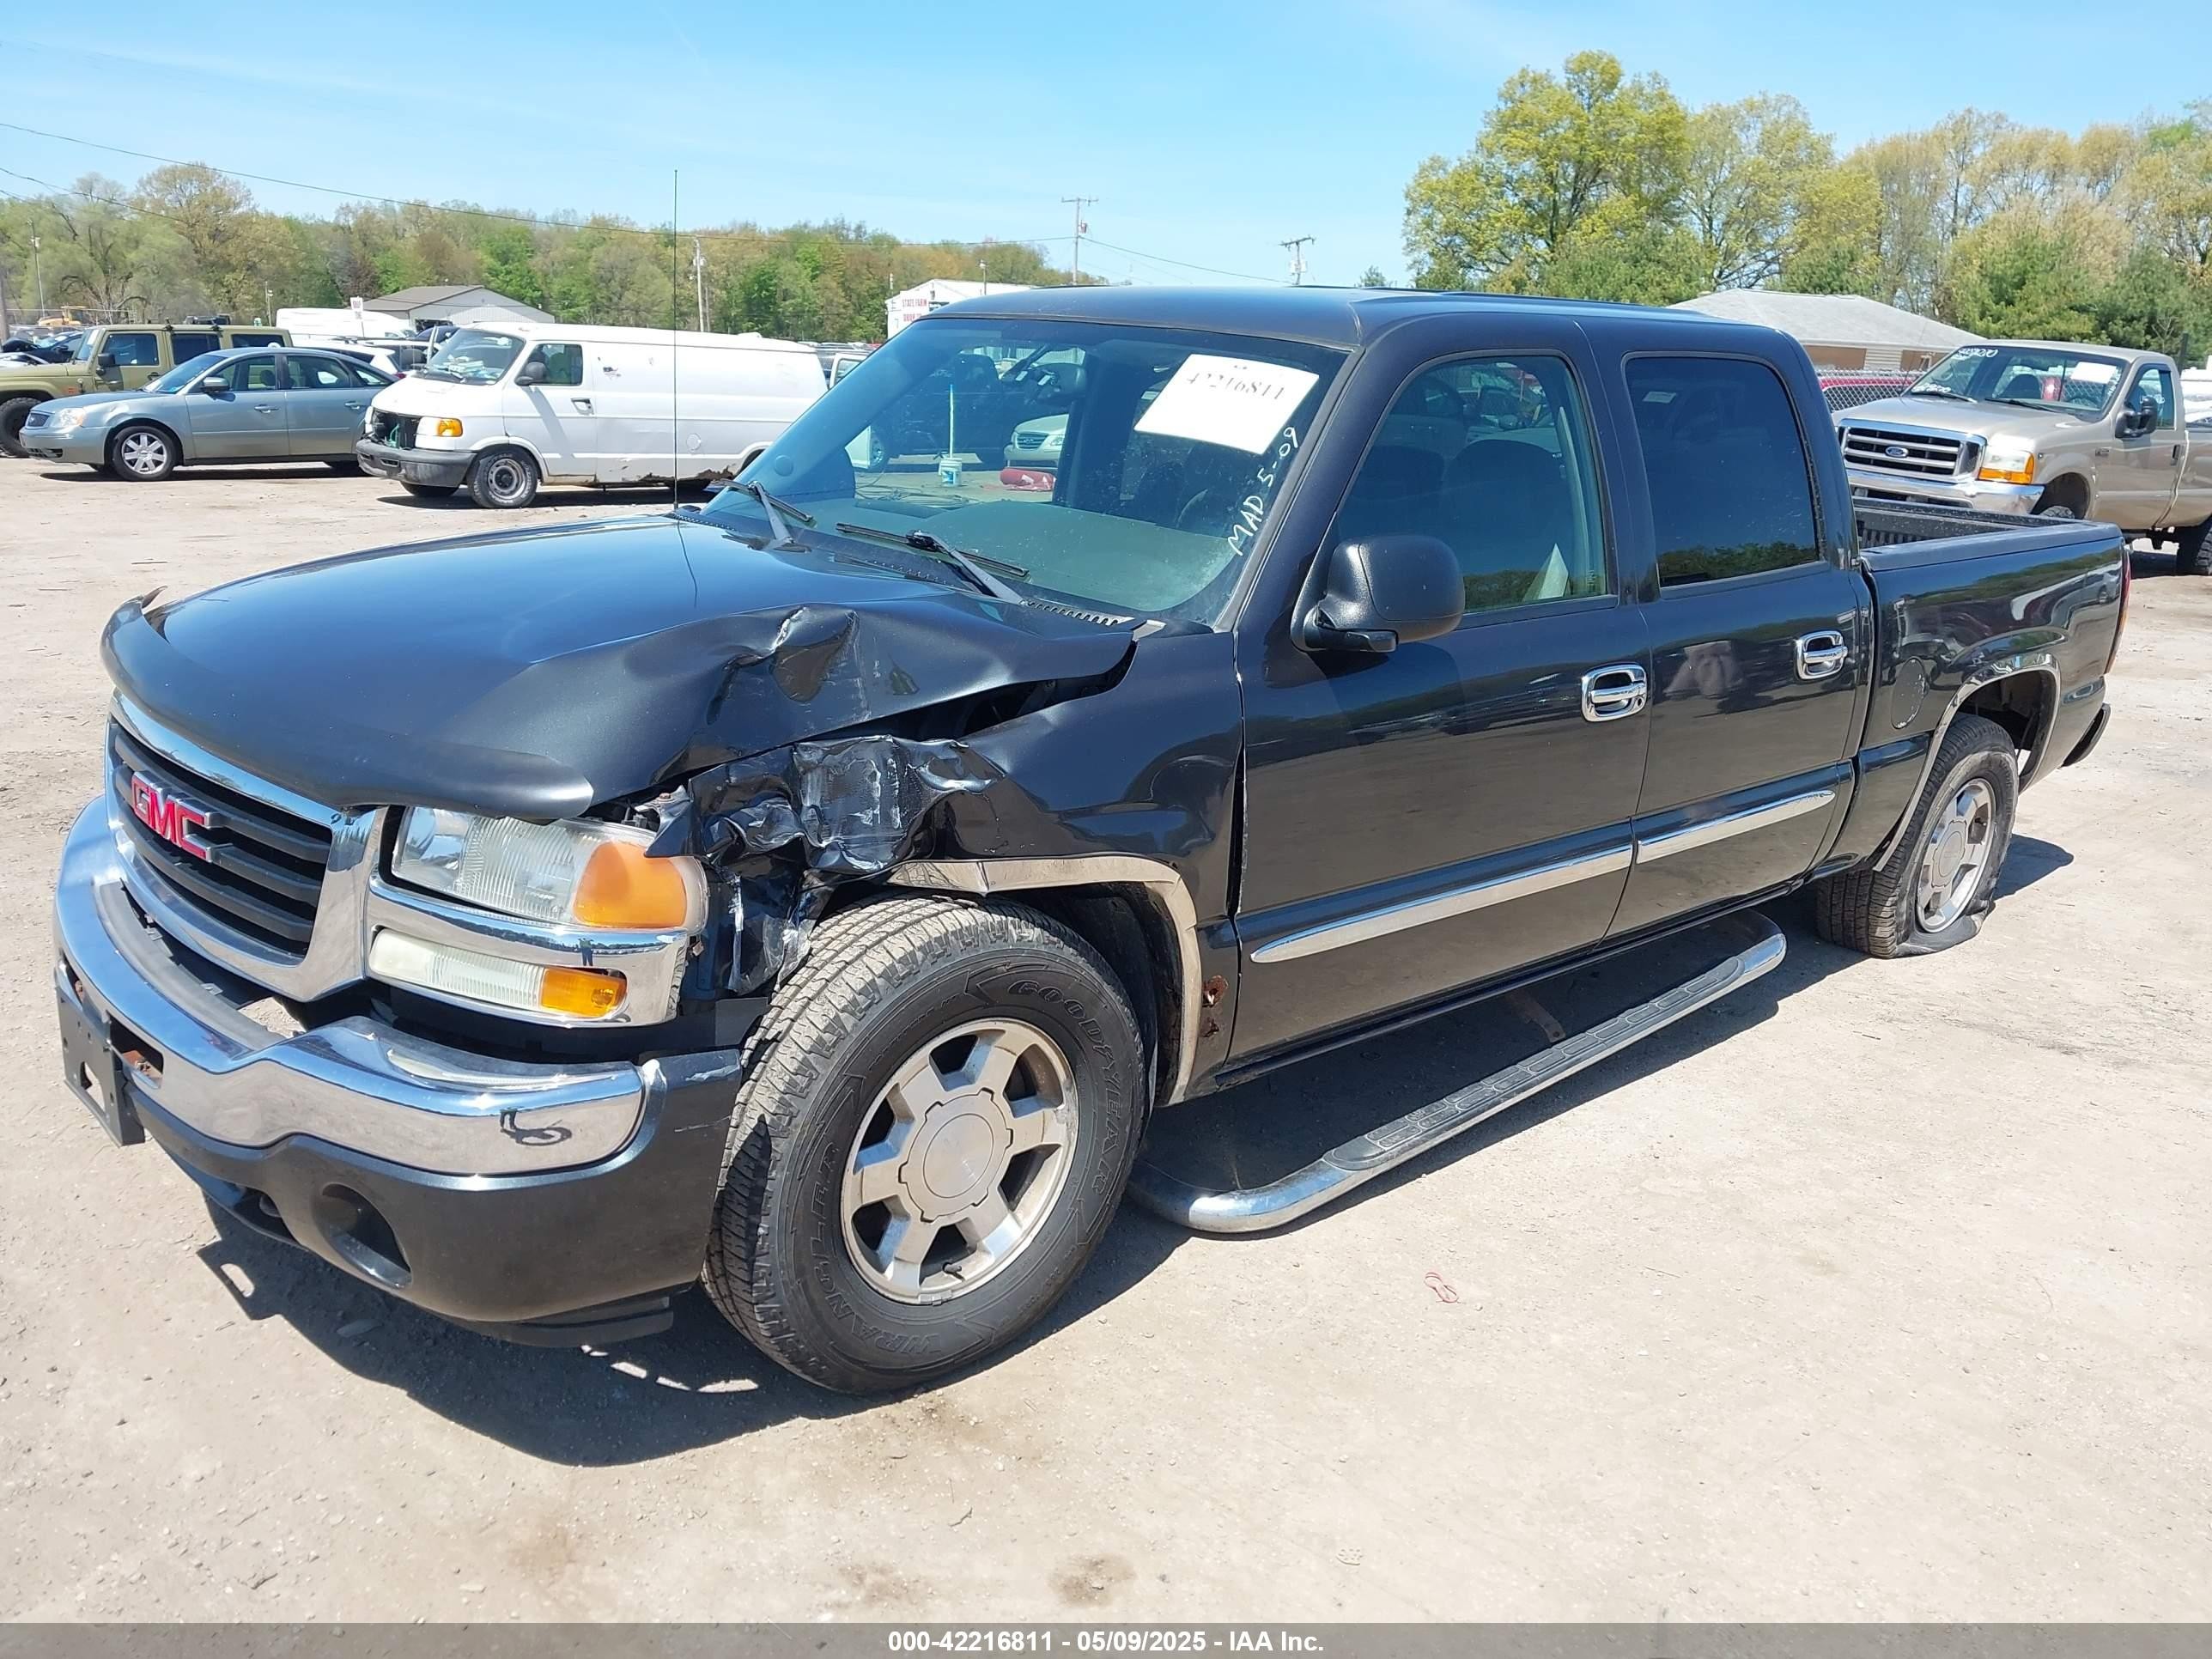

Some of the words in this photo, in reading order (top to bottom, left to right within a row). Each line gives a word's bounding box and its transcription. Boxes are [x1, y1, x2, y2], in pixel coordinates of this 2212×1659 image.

[1227, 495, 1264, 556] MAD
[1256, 427, 1298, 488] 5-09
[131, 772, 212, 863] GMC
[1008, 979, 1121, 1195] GOODYEAR
